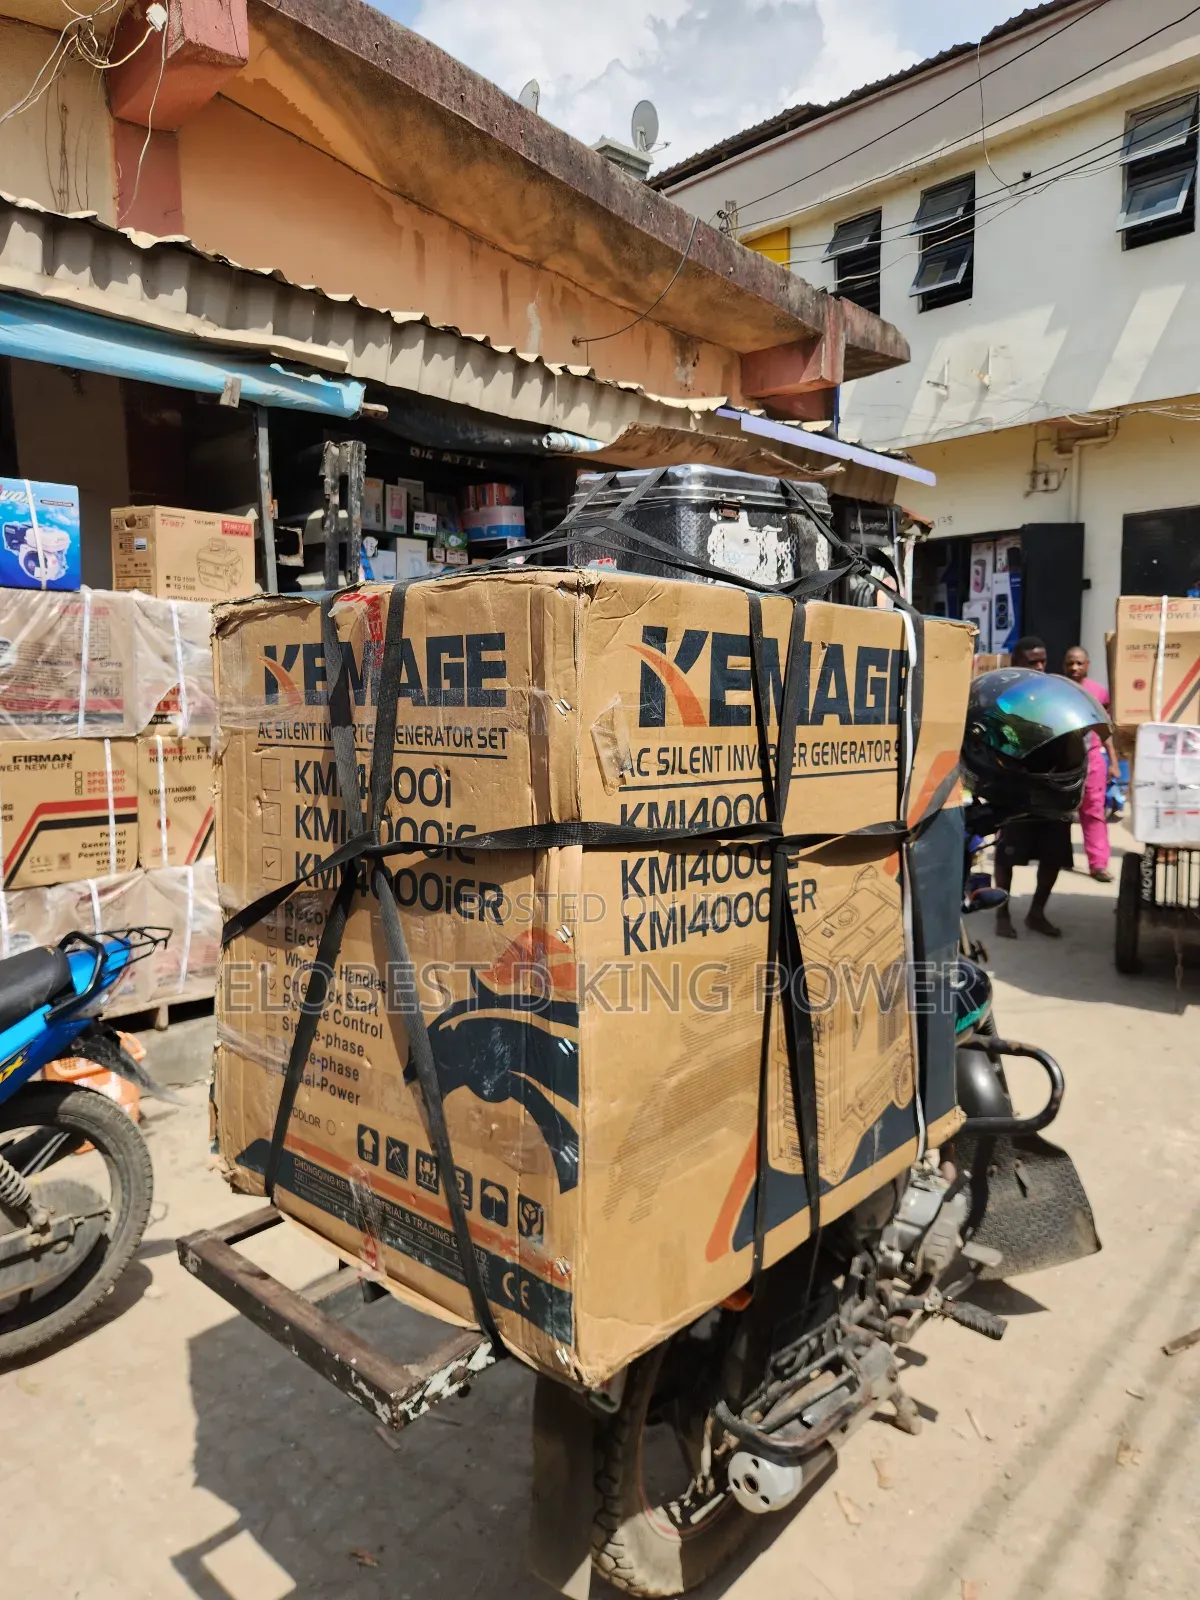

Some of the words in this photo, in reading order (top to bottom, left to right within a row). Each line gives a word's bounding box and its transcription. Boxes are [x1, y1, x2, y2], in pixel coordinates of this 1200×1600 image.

[258, 721, 273, 739] AC
[275, 721, 317, 741] SILENT
[394, 726, 473, 750] ENERATOR
[477, 727, 509, 750] SET
[12, 753, 73, 763] FIRMAN
[656, 745, 723, 777] SILENT
[727, 742, 808, 773] INVRER
[811, 739, 892, 767] GENERATOR
[294, 759, 452, 808] KM400i
[295, 805, 477, 865] KMI000iE
[284, 901, 329, 939] Recoi
[622, 878, 818, 956] KMI4000ER
[284, 926, 322, 948] Elect
[339, 964, 388, 994] Handles
[346, 993, 379, 1017] Start
[333, 1009, 384, 1040] Control
